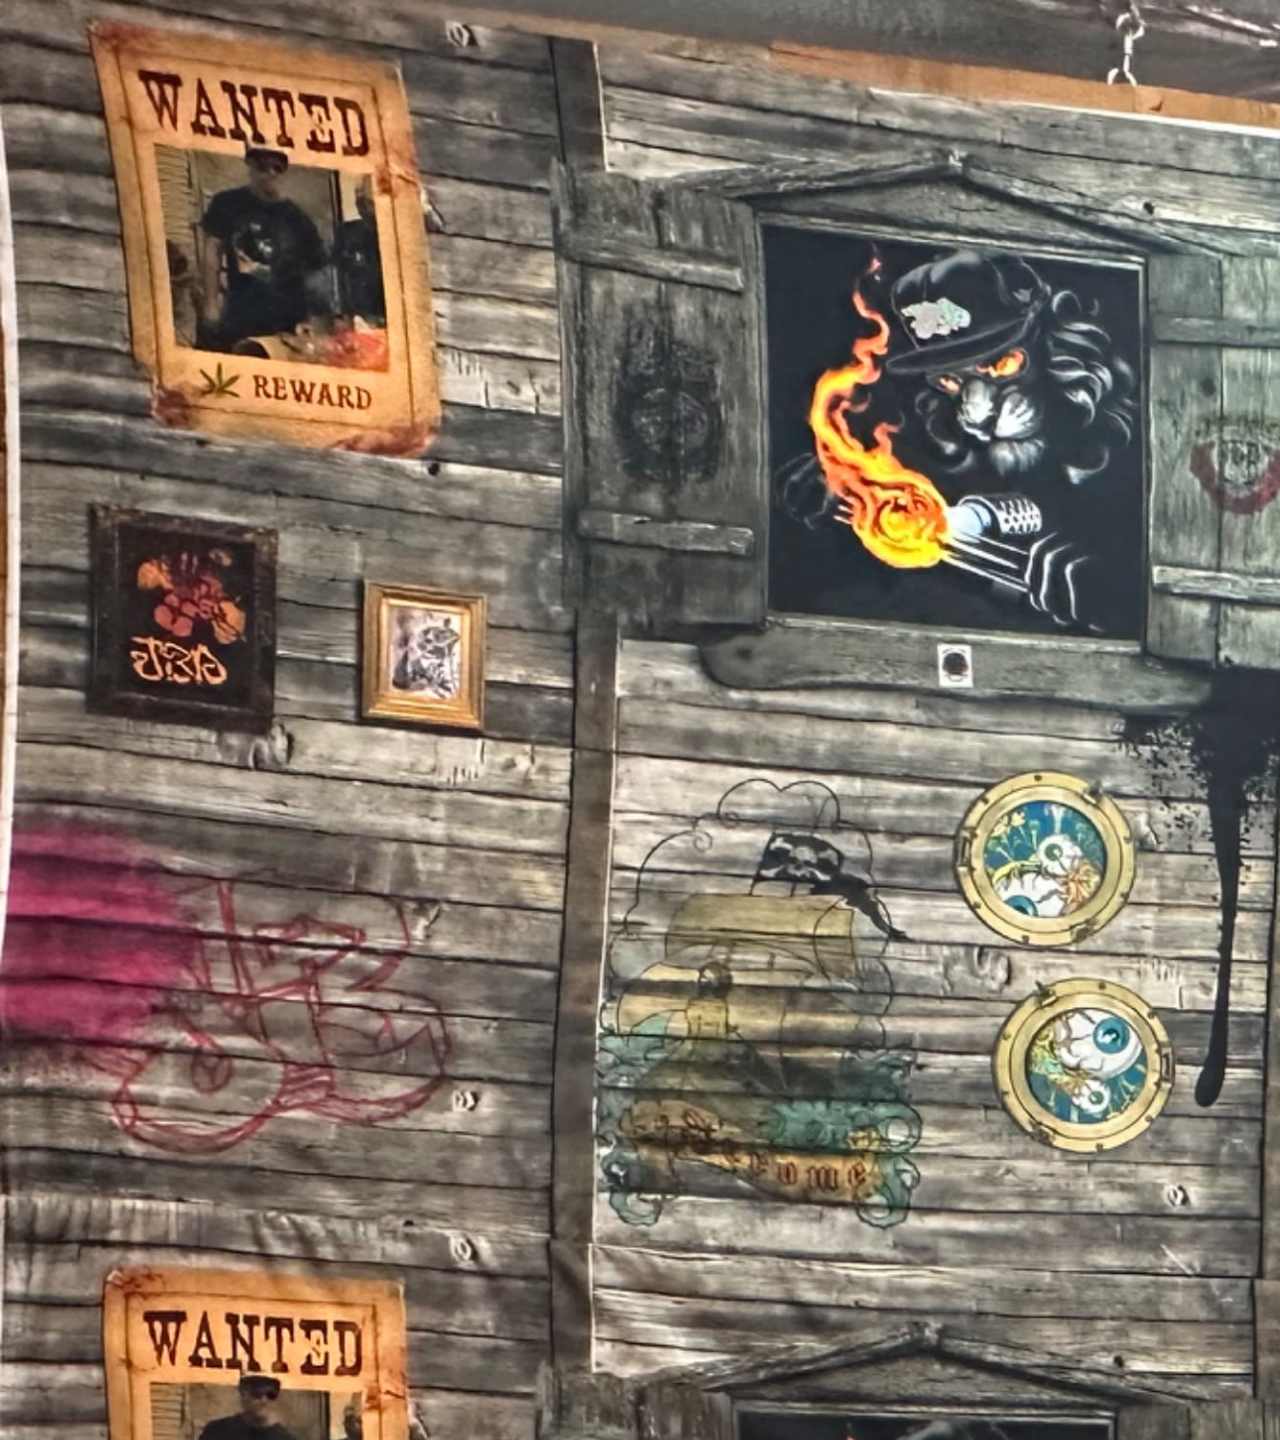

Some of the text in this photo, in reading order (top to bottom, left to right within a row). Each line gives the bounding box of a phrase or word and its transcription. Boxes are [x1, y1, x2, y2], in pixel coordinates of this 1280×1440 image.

[138, 69, 369, 157] WANTED
[253, 375, 372, 410] REWARD
[143, 1310, 362, 1376] WANTED
